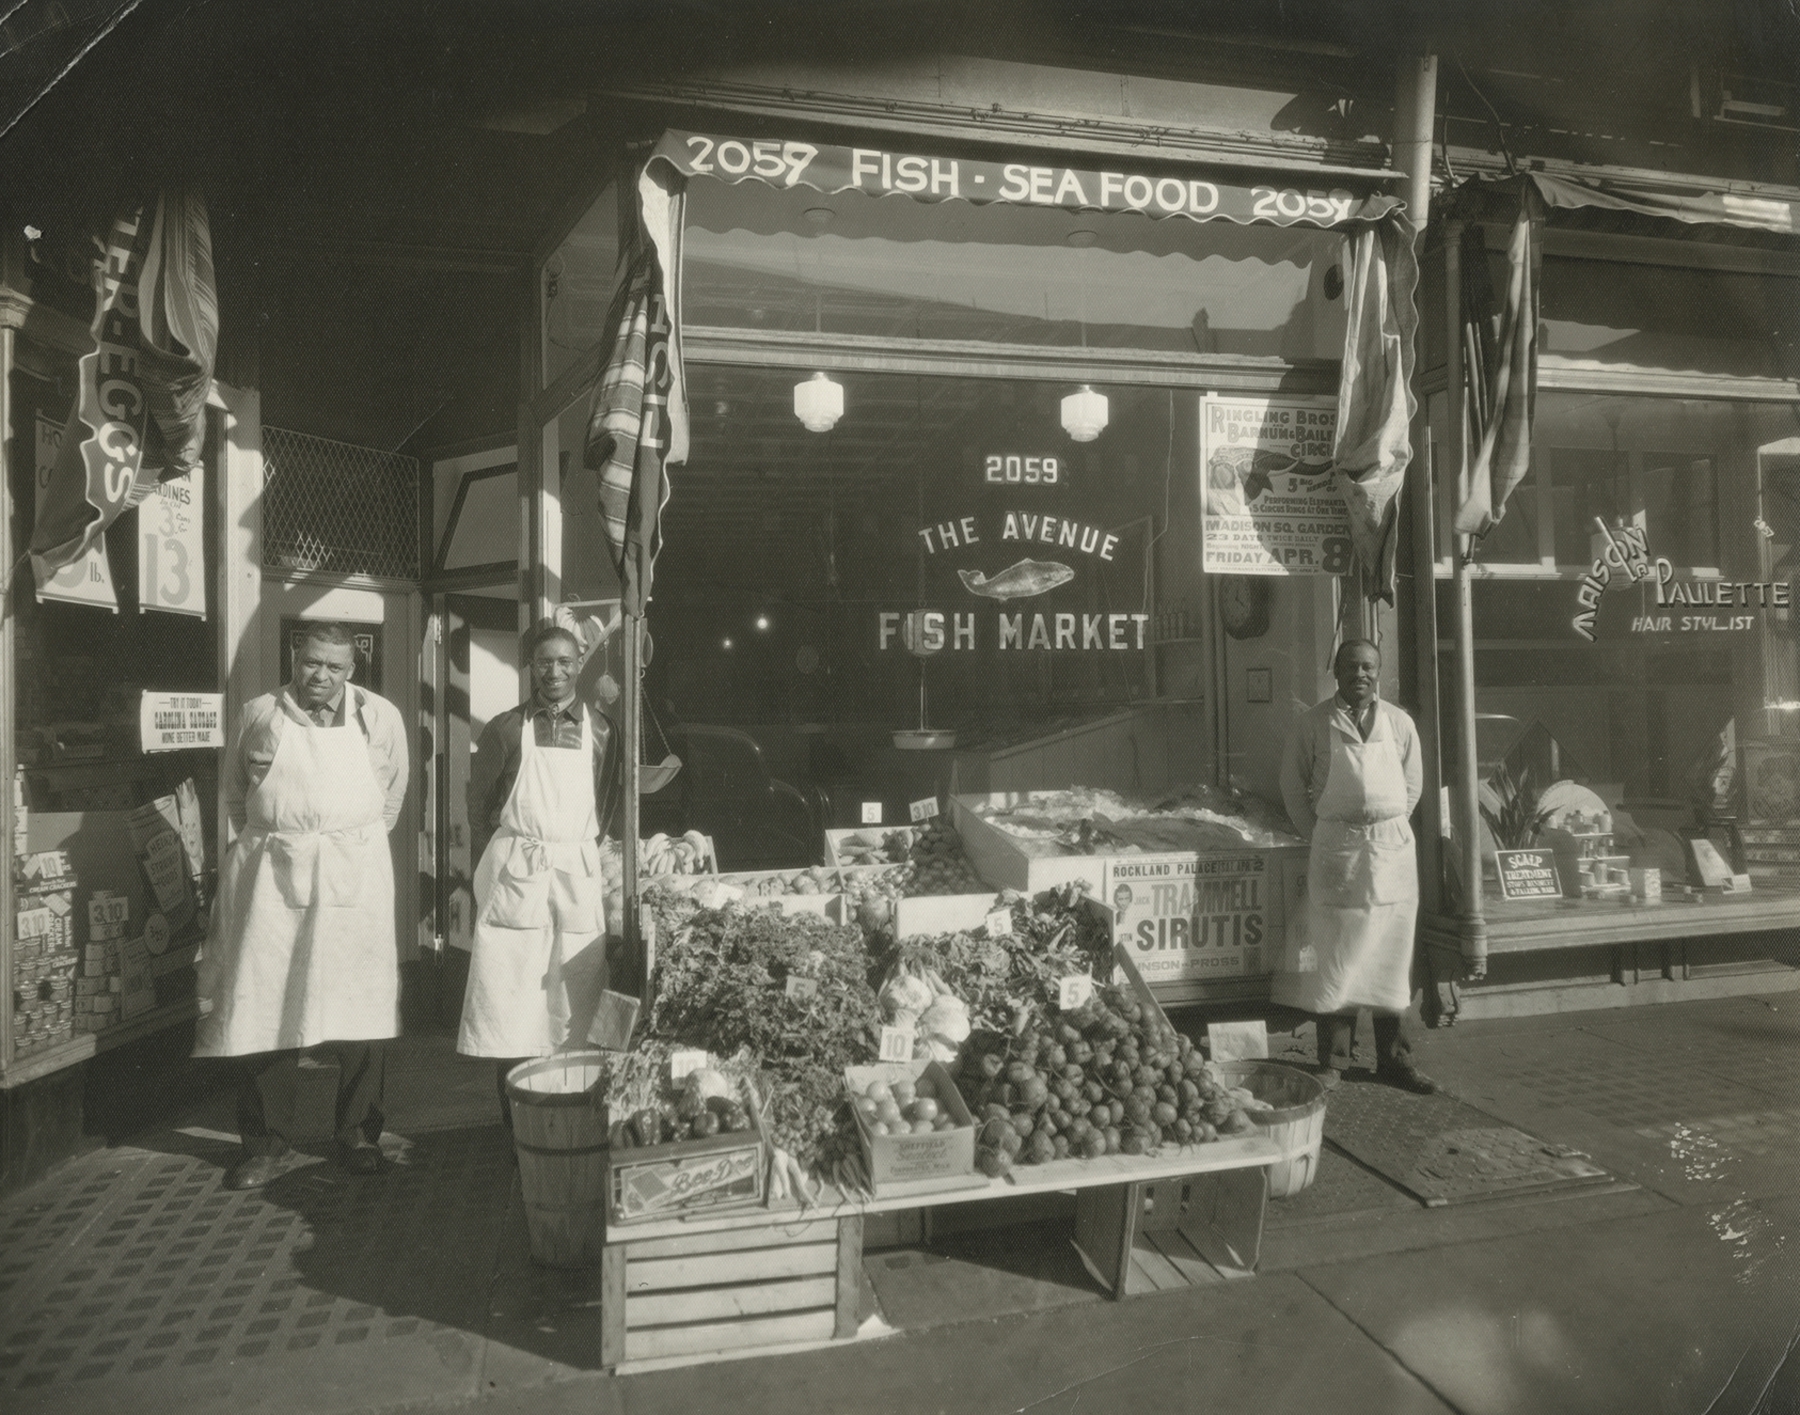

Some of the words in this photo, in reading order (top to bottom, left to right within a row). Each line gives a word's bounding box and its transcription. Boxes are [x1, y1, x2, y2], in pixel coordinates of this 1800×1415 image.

[686, 136, 818, 188] 2059
[852, 147, 959, 194] FISH
[1000, 164, 1089, 208] SEA
[1100, 172, 1220, 214] FOOD
[1211, 406, 1290, 433] RINGLING
[1227, 423, 1288, 443] BARNUM
[1295, 426, 1333, 443] BAILE
[986, 456, 1058, 483] 2059
[1287, 477, 1298, 493] 5
[158, 506, 175, 537] 3
[1205, 519, 1271, 533] MADISON
[918, 516, 980, 554] THE
[1002, 512, 1119, 561] AVENUE
[1205, 533, 1228, 541] 23
[1233, 534, 1263, 542] DAYS
[1267, 534, 1294, 542] TWICE
[1295, 535, 1319, 543] DAILY
[1205, 551, 1263, 563] FRIDAY
[1268, 548, 1319, 564] APR.
[1322, 537, 1354, 573] 8
[1656, 557, 1790, 608] PAULETTE
[879, 612, 975, 650] FISH
[999, 612, 1149, 650] MARKET
[1631, 616, 1672, 632] HAIR
[1681, 615, 1755, 632] STYLIST
[155, 711, 186, 729] CAROLINA
[866, 806, 876, 822] 5
[1113, 863, 1171, 877] ROCKLAND
[1177, 861, 1217, 875] PALACE
[1507, 853, 1544, 869] SCALP
[1504, 867, 1553, 880] TREATMENT
[1151, 880, 1262, 916] TRAMMELL
[994, 917, 1004, 934] 5
[1136, 913, 1263, 952] SIRUTIS
[1066, 982, 1080, 1004] 5
[886, 1033, 905, 1051] 10
